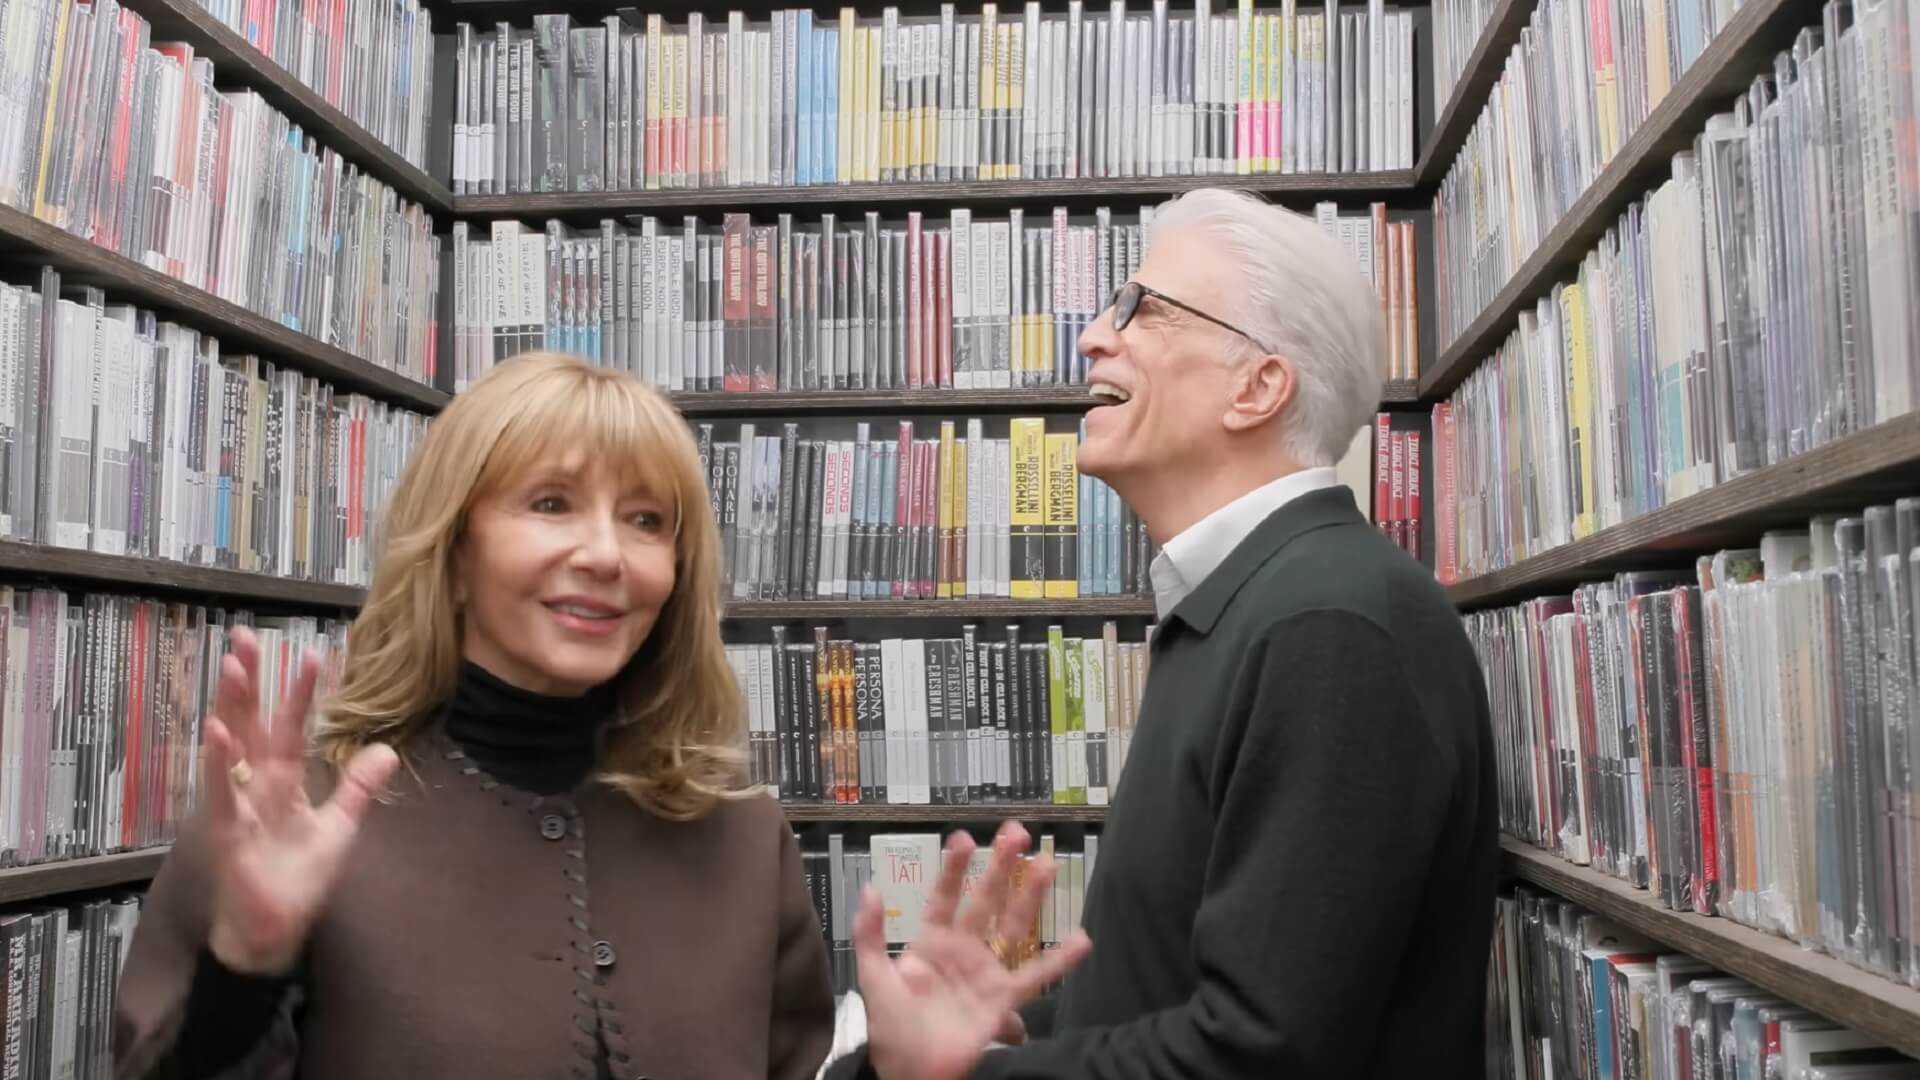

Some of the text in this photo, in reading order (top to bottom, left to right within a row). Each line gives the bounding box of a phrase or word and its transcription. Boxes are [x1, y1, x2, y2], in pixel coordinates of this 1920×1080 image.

[642, 236, 652, 310] PURPLE NOON
[656, 241, 665, 314] PURPLE NOON
[671, 245, 680, 319] PURPLE NOON
[825, 453, 837, 514] SECONDS
[840, 450, 850, 513] SECONDS
[1015, 463, 1026, 513] BERGMAN
[1027, 456, 1040, 513] ROSSELLINI
[1049, 471, 1061, 521] BERGMAN
[1062, 464, 1073, 521] ROSSELLINI
[855, 657, 868, 720] PERSONA
[869, 657, 882, 720] PERSONA
[928, 665, 942, 718] FRESHMAN
[948, 667, 962, 720] FRESHMAN
[889, 854, 923, 885] TATI
